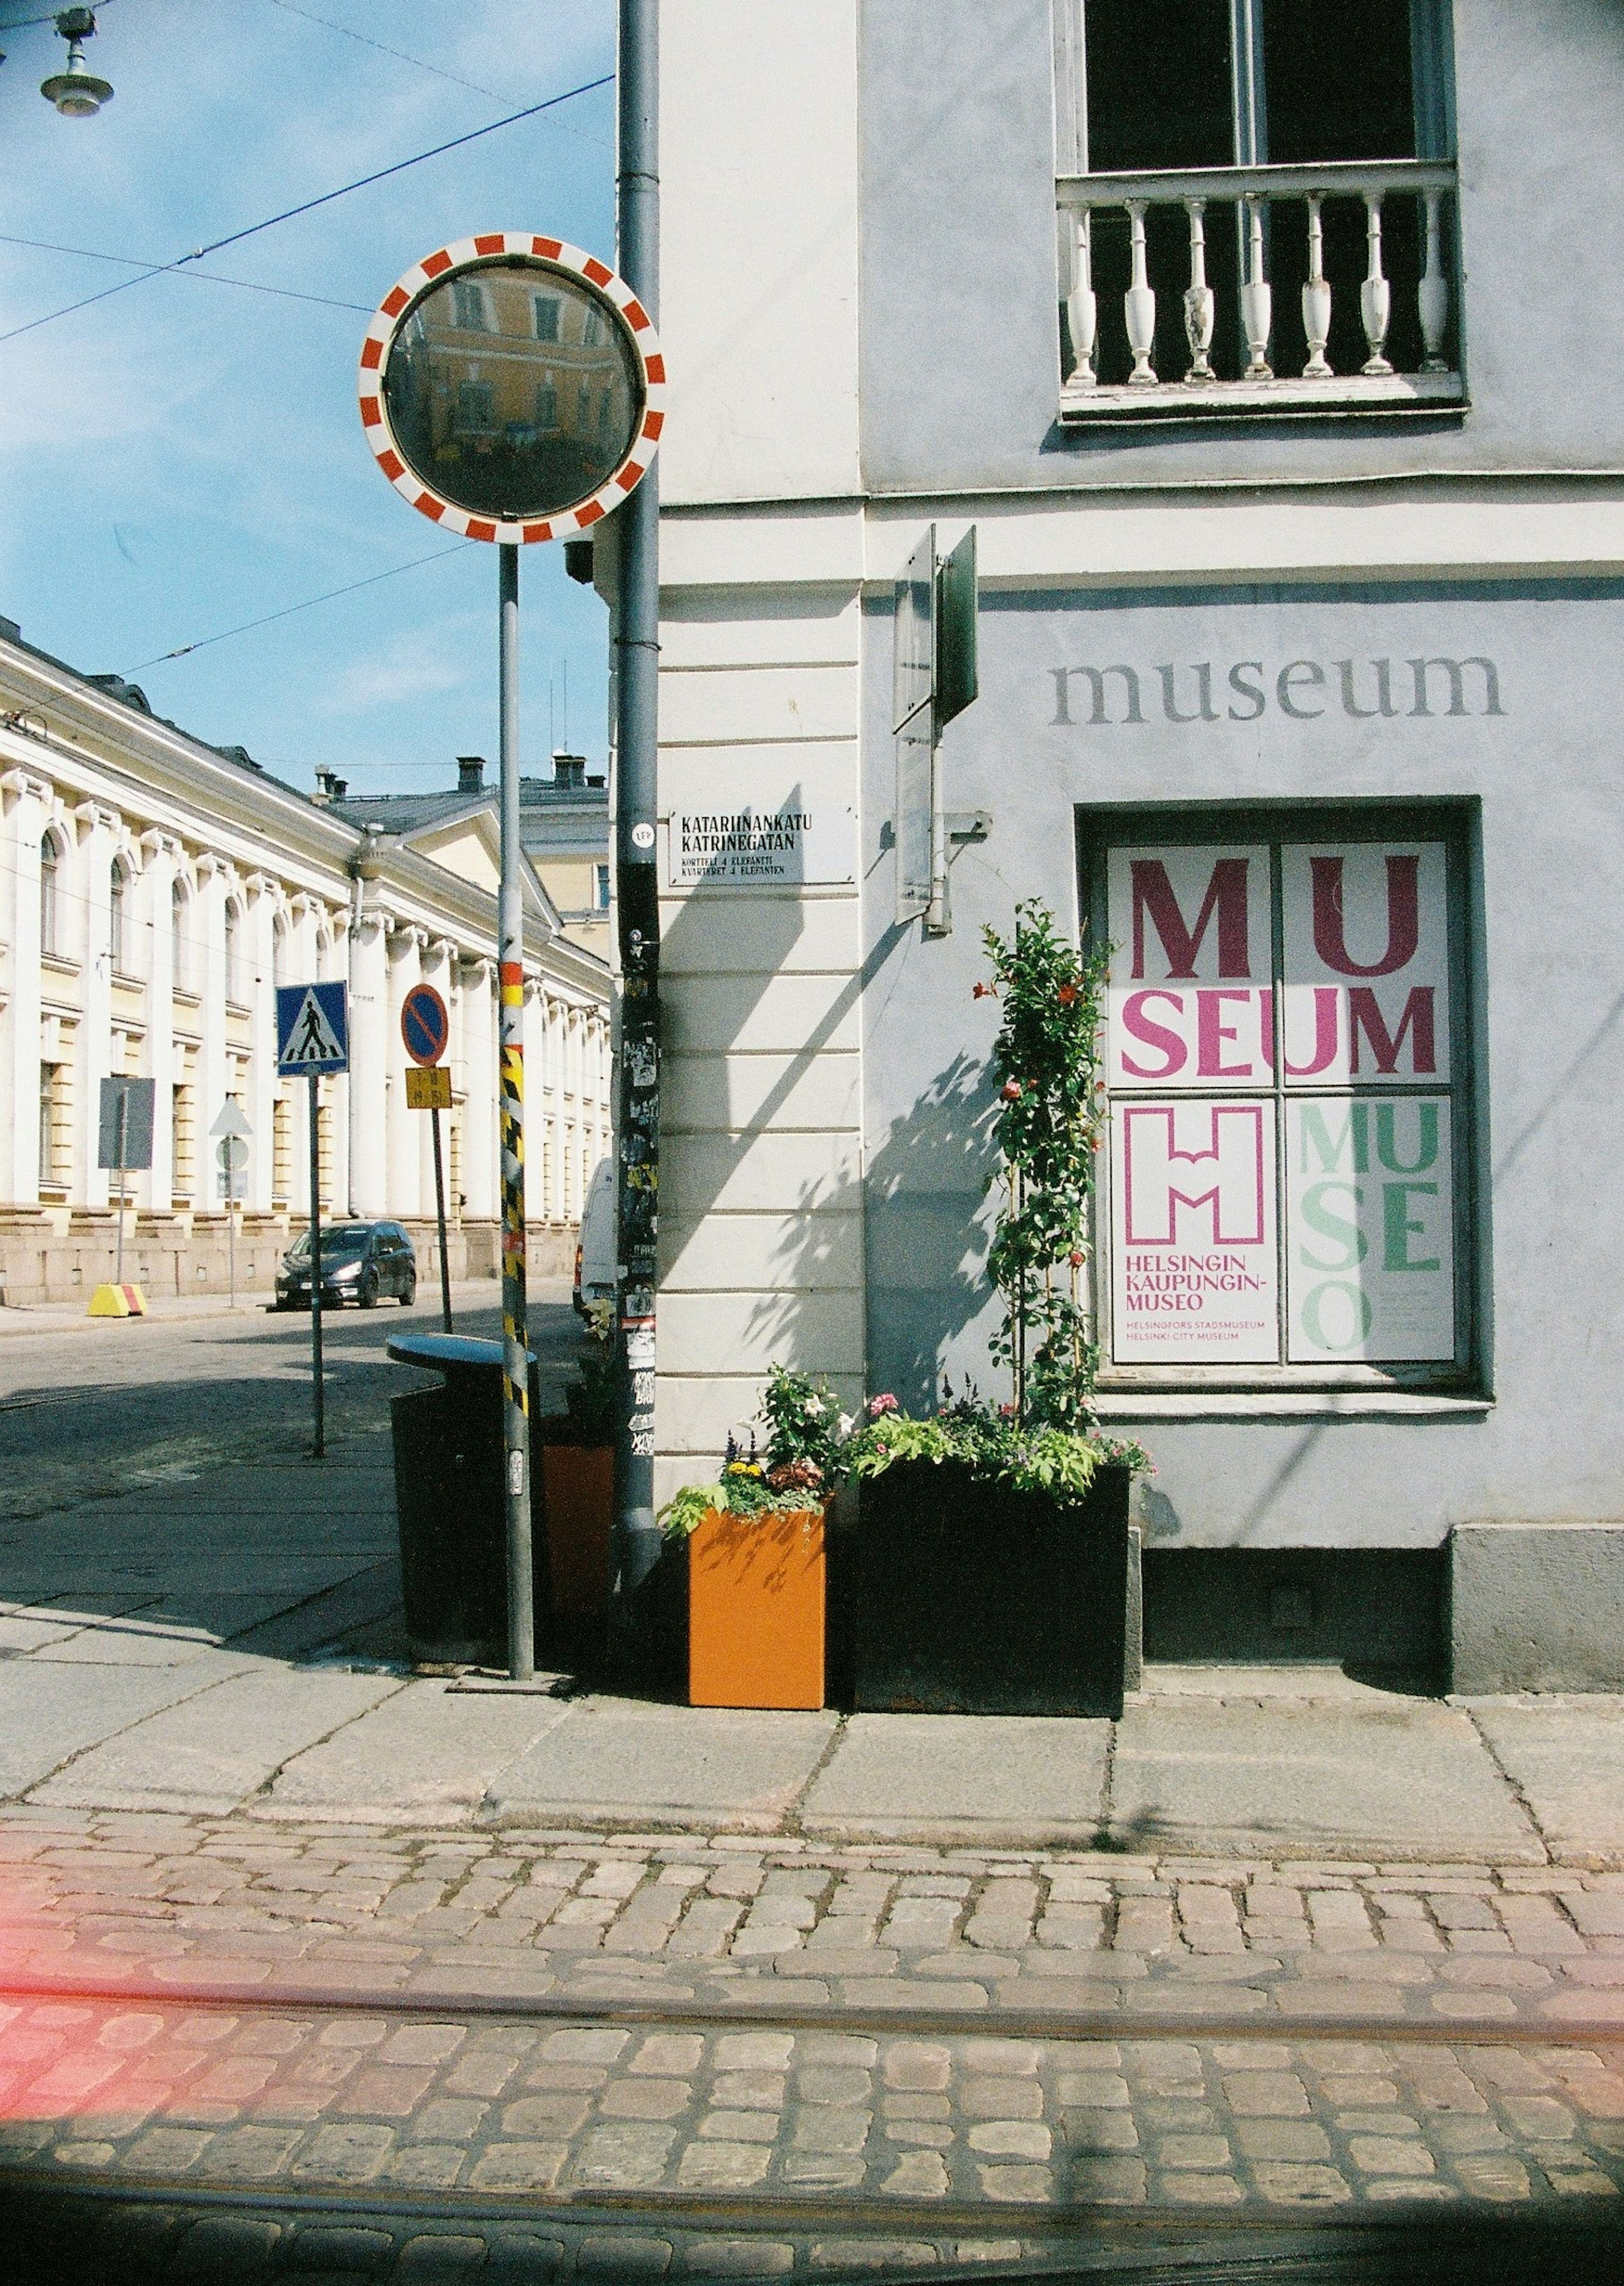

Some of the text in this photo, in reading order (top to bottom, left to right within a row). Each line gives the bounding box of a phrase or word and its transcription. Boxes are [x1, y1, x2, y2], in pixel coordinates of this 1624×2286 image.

[1047, 656, 1509, 726] museum
[682, 814, 812, 833] KATARIINANKATU
[682, 833, 794, 852] KATRINEGATAN
[682, 858, 717, 866] KORTTELI
[1130, 855, 1420, 979] MU
[1121, 986, 1437, 1079] SEUM
[1299, 1102, 1439, 1175] MU
[1300, 1180, 1441, 1273] SE
[1126, 1255, 1246, 1272] HELSINGIN
[1126, 1274, 1267, 1291] KAUPUNGIN-
[1126, 1294, 1203, 1311] MUSEO
[1126, 1321, 1265, 1329] HELSINGFORS STADSMUSEUM
[1300, 1280, 1373, 1353] O
[1126, 1332, 1239, 1341] HELSINKI CITY MUSEUM
